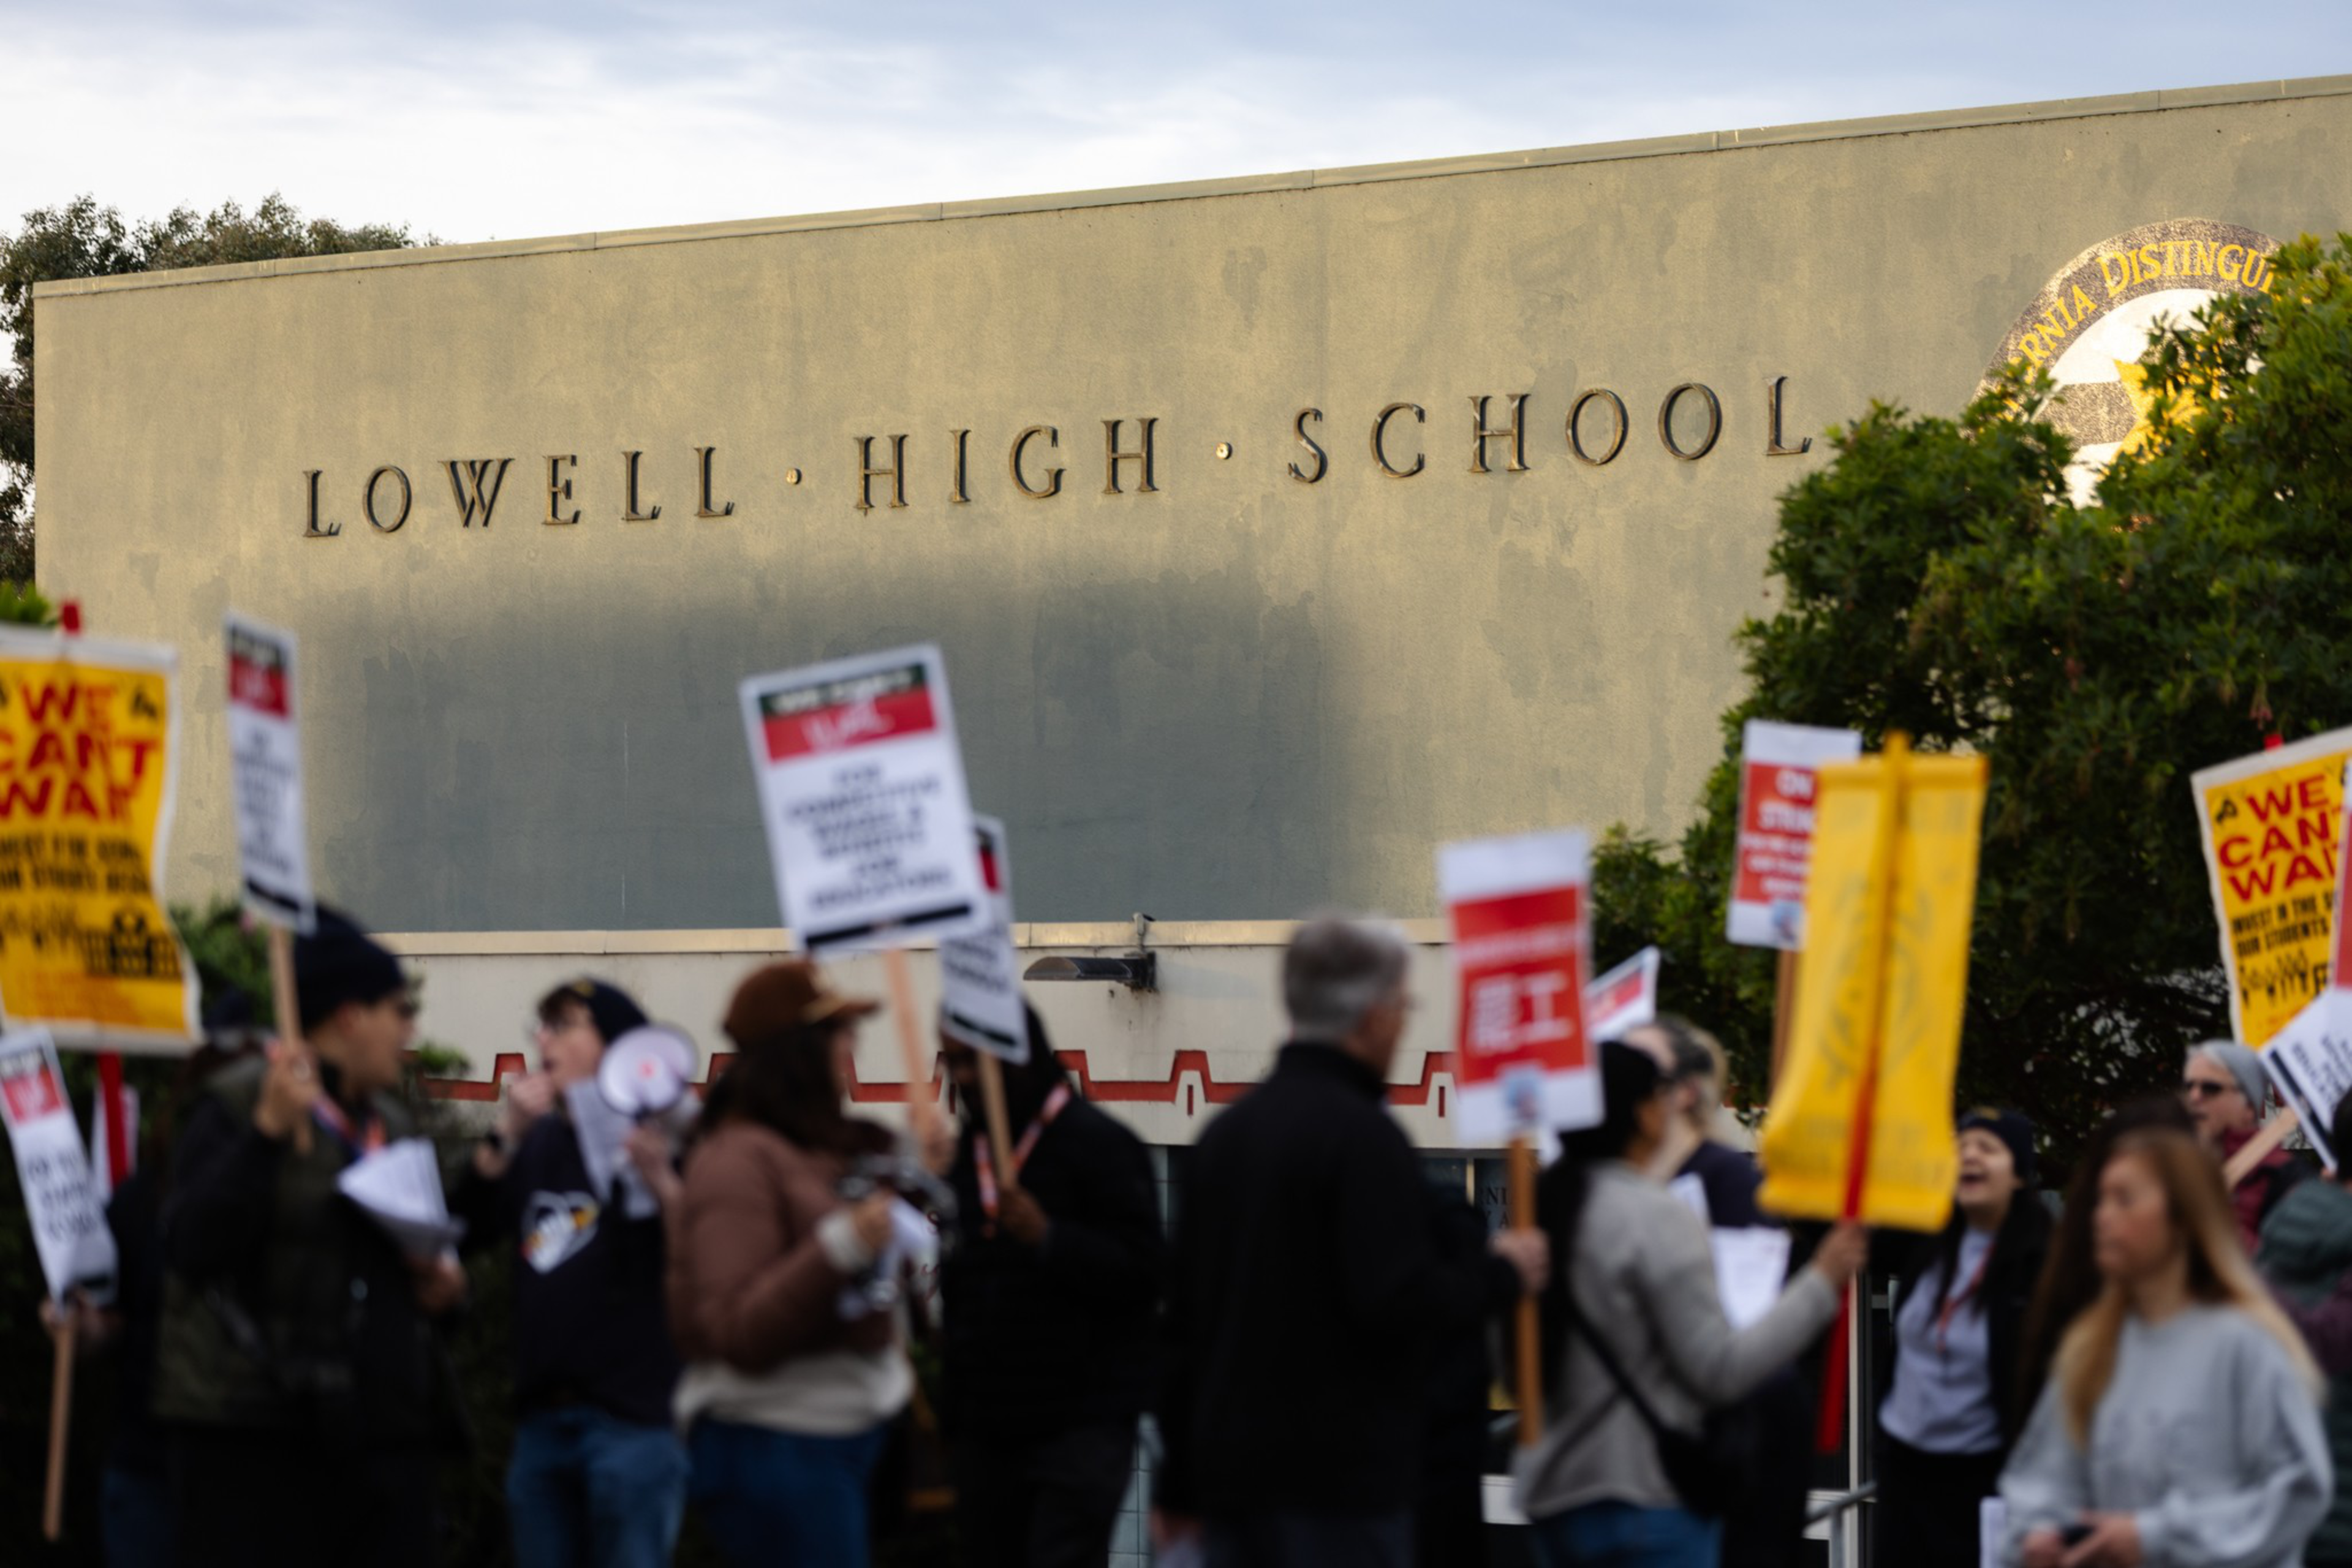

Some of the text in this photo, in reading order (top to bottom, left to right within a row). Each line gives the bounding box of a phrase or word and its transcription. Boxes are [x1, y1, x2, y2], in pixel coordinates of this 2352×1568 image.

[2008, 284, 2098, 383] RNIA
[303, 376, 1812, 538] LOWELL HIGH SCHOOL
[22, 684, 116, 733] WE
[2246, 774, 2329, 823] WE
[2219, 807, 2341, 870] CAN
